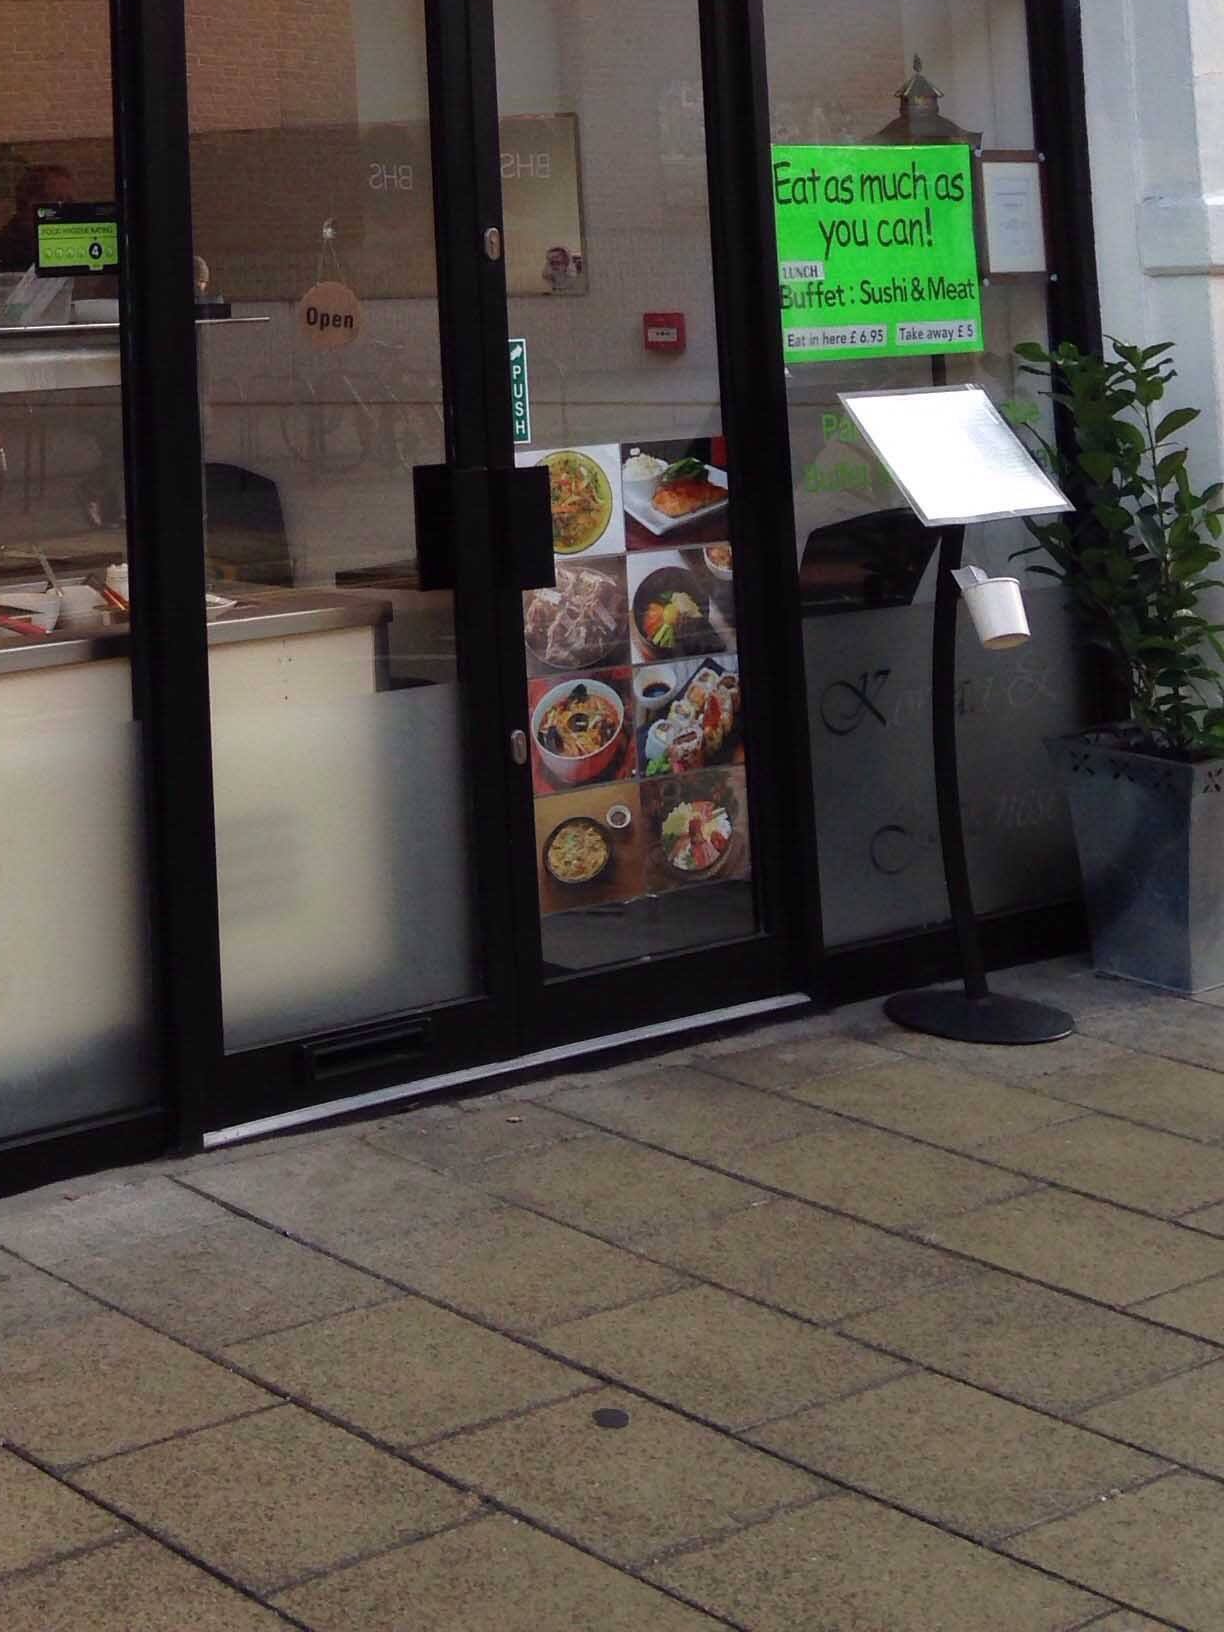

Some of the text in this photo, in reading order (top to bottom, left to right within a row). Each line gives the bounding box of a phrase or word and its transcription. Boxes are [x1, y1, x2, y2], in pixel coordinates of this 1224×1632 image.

[773, 160, 965, 206] Eat as much as
[819, 206, 934, 261] you can!
[859, 276, 908, 305] Sushi
[910, 276, 926, 302] &
[927, 275, 976, 302] Meat
[306, 306, 354, 332] Open
[787, 333, 806, 348] Eat
[809, 332, 820, 346] in
[822, 331, 848, 346] here
[899, 327, 924, 341] Take
[926, 327, 954, 343] away
[512, 364, 527, 435] PUSH
